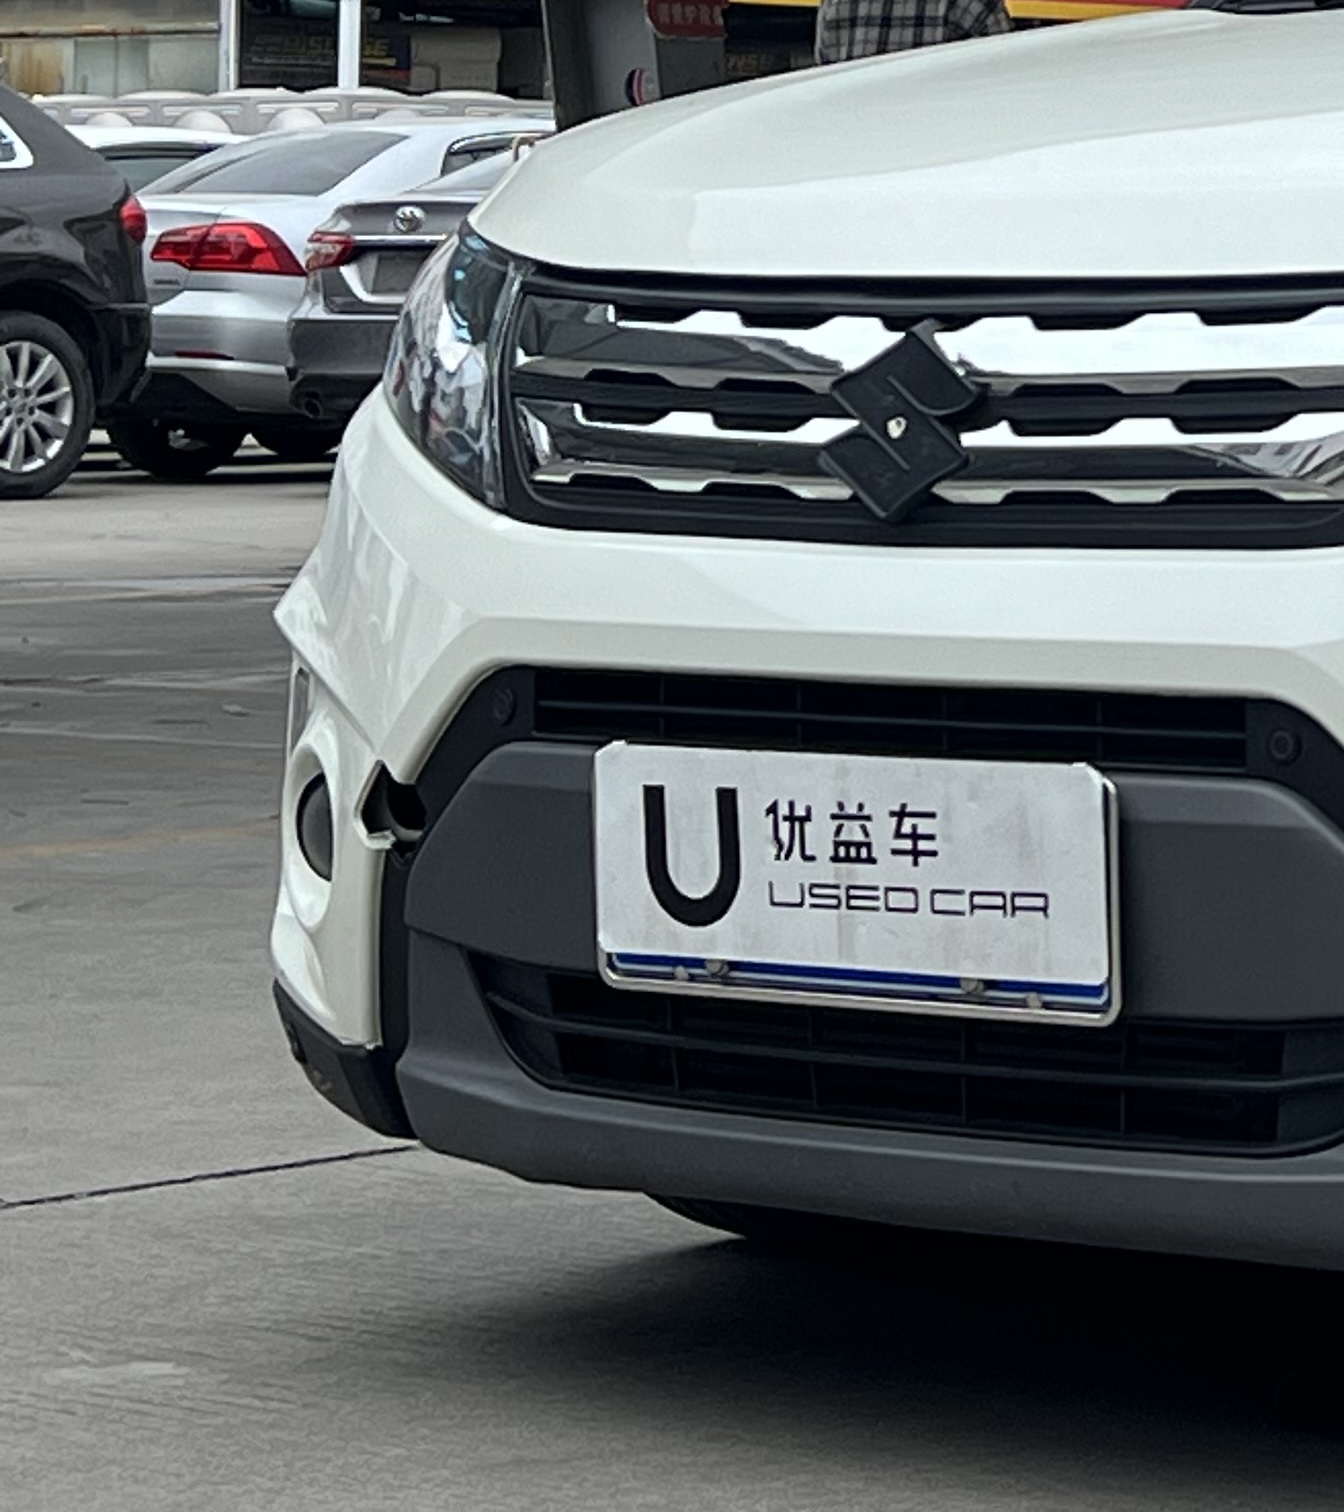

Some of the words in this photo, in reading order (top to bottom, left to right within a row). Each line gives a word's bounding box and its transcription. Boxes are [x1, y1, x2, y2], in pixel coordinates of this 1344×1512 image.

[643, 784, 741, 927] U
[765, 799, 939, 867] 优益车
[768, 880, 919, 914] USED
[930, 888, 1049, 919] CAR
